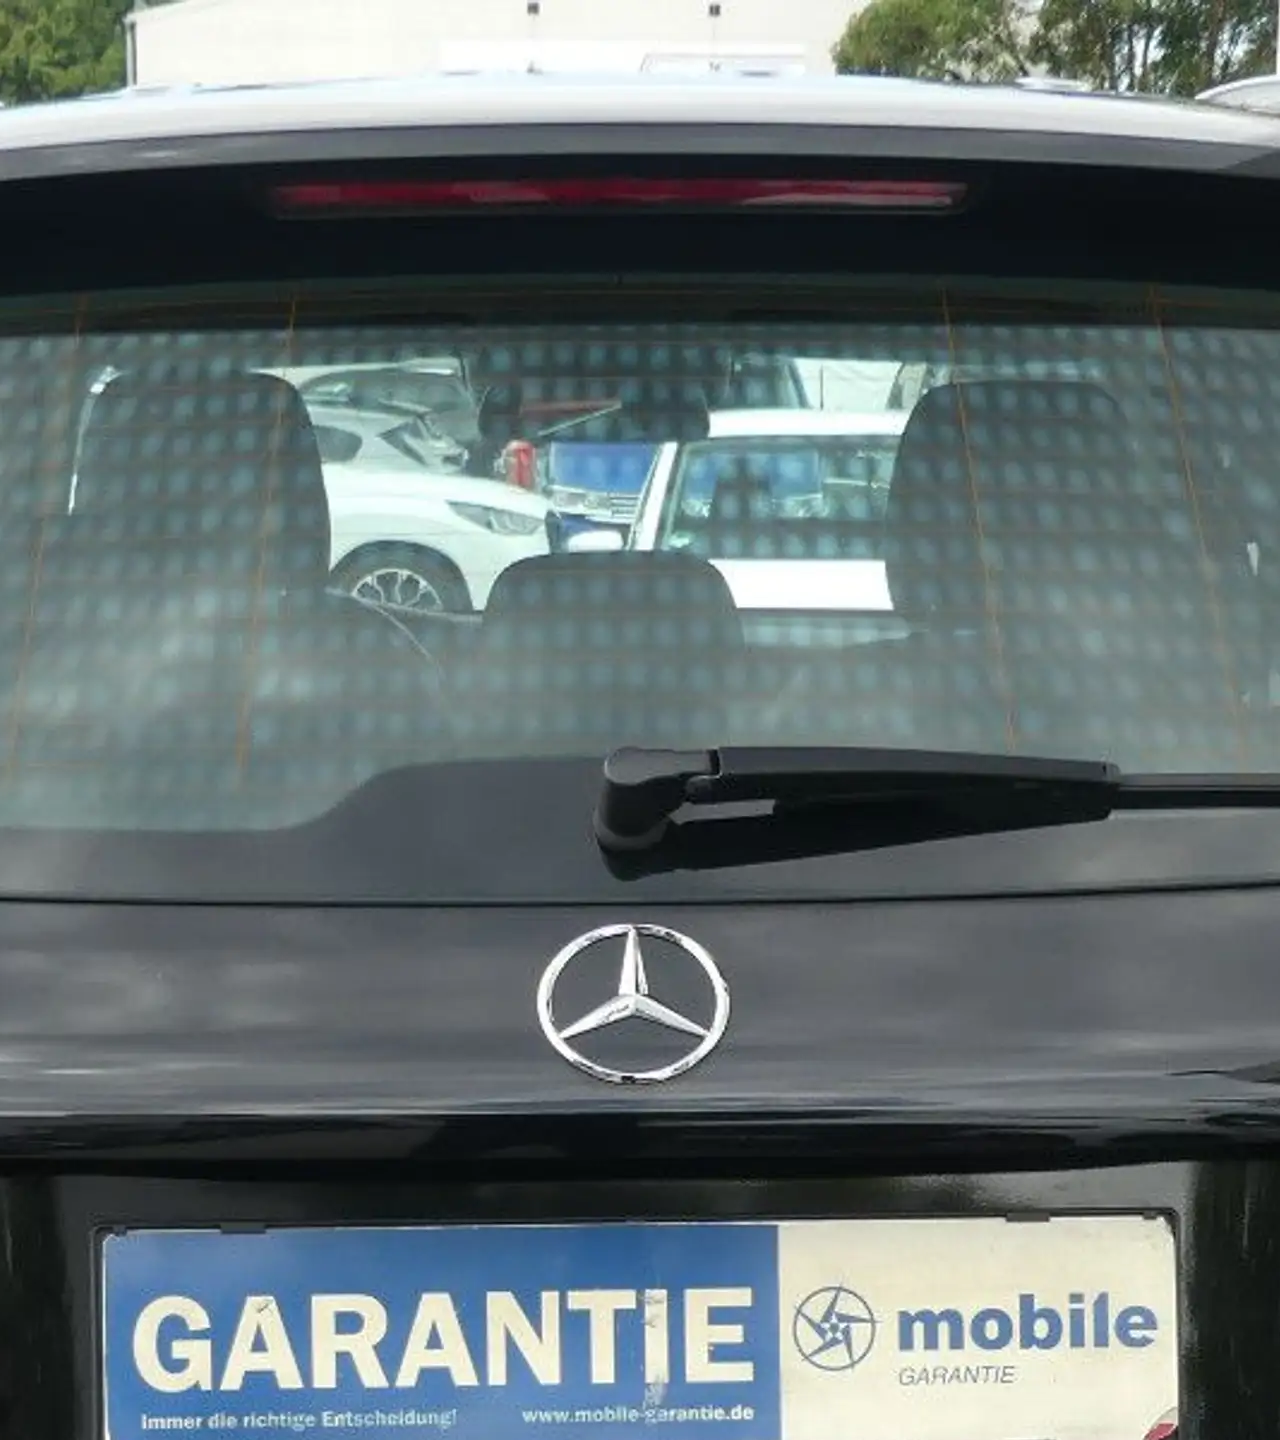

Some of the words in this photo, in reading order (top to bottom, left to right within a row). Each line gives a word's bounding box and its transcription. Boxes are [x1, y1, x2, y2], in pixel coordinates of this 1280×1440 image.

[897, 1291, 1159, 1352] mobile
[133, 1287, 754, 1393] GARANTIE
[898, 1365, 1018, 1387] GARANTIE
[141, 1413, 202, 1430] Immer
[208, 1411, 237, 1429] die
[242, 1409, 316, 1432] richtige
[322, 1407, 457, 1428] Entscheidung!
[522, 1403, 754, 1425] www.mobile-garantie.de
